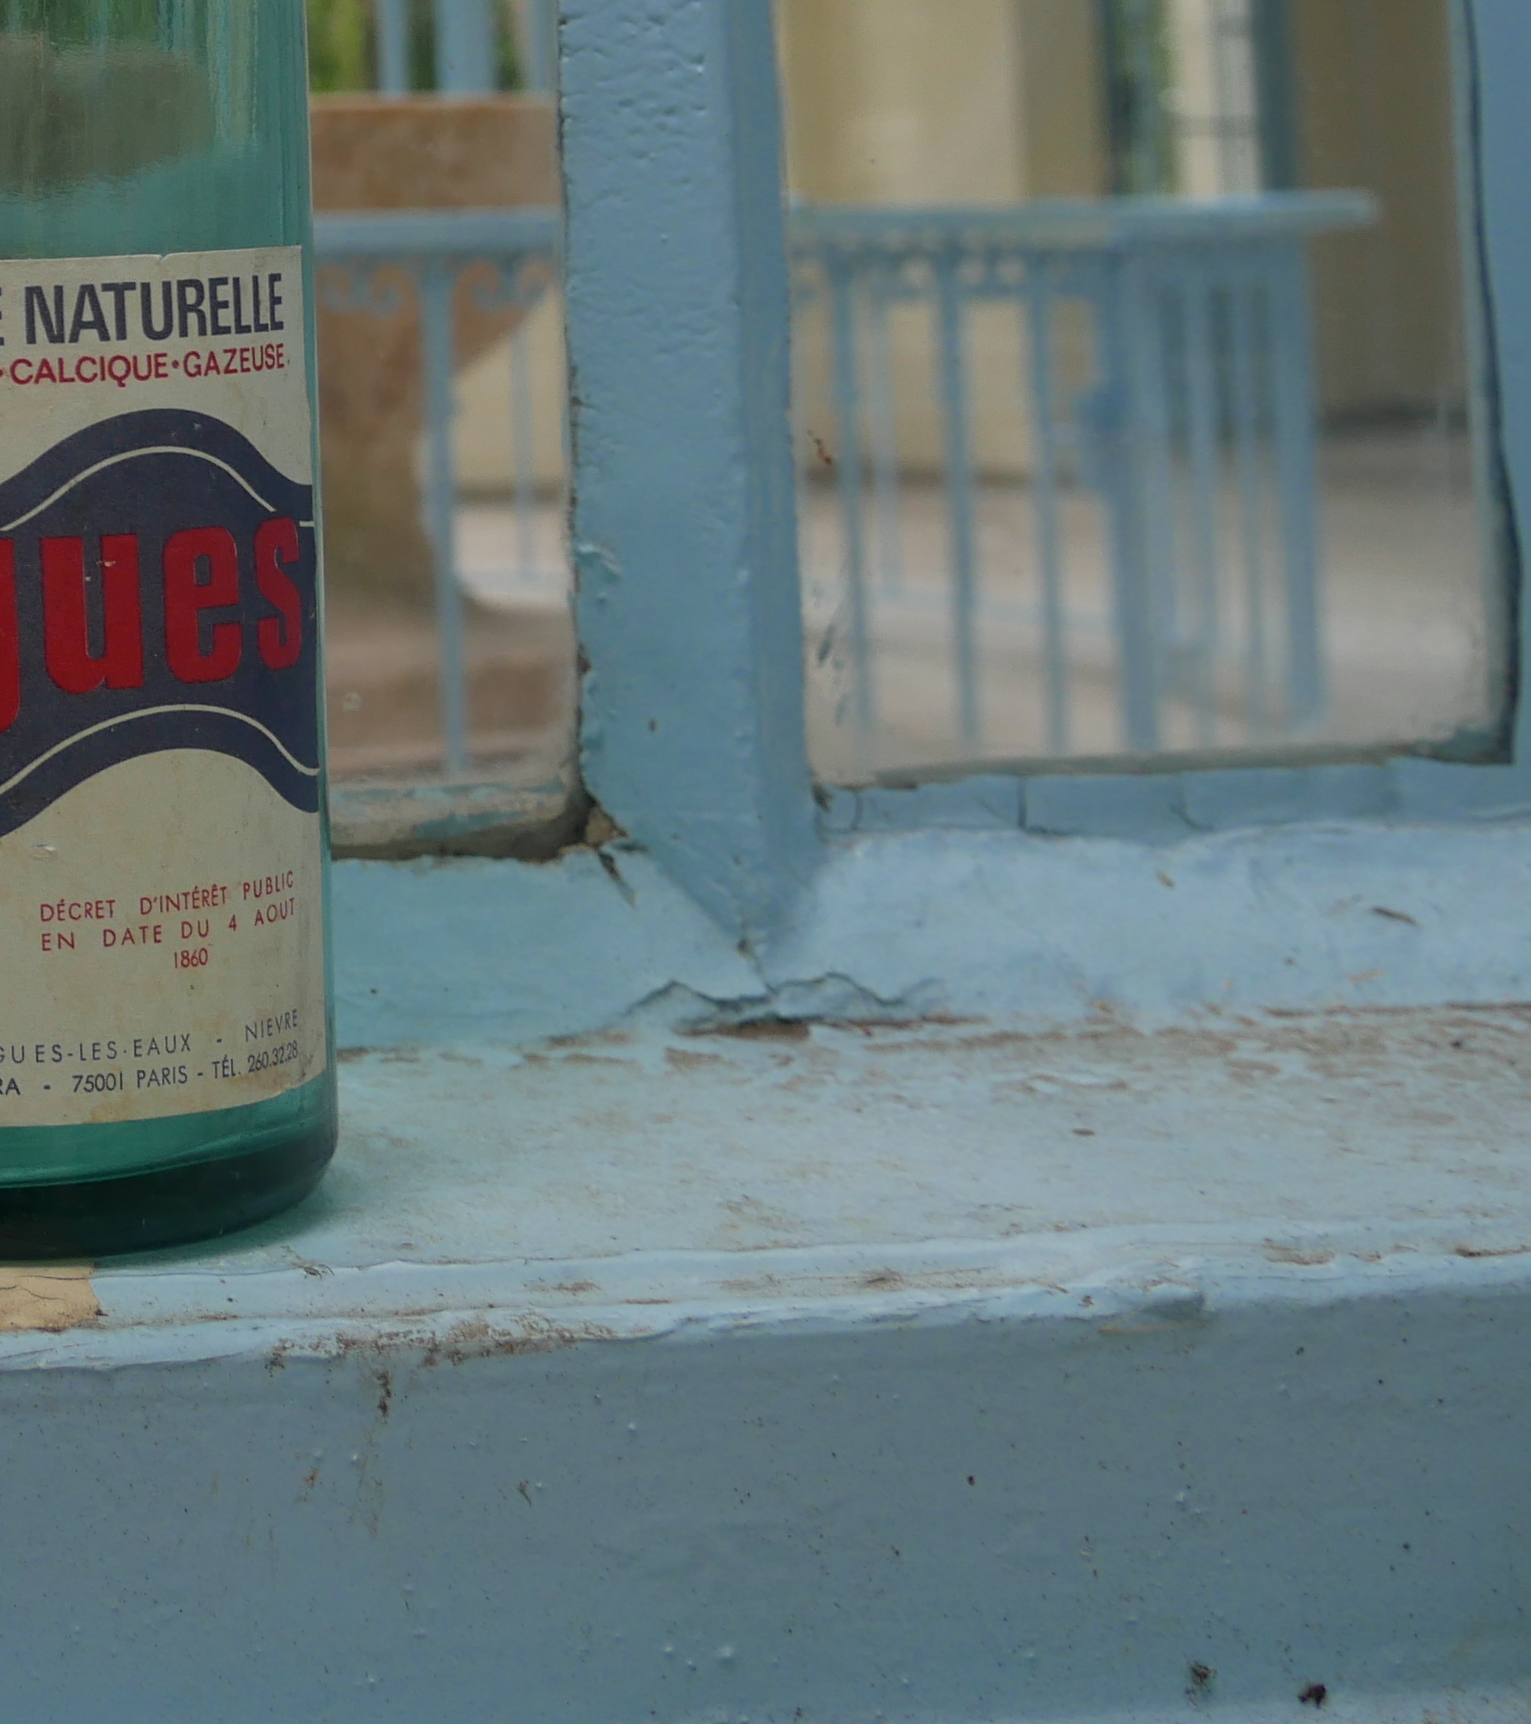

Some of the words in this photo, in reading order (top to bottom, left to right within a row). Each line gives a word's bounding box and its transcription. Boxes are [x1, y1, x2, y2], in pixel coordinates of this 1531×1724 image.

[24, 272, 285, 345] NATURELLE
[9, 351, 169, 389] CALCIQUE
[183, 342, 286, 377] GAZEUSE
[39, 898, 116, 923] DÉCRET
[139, 883, 228, 916] D'INTÉRÊT
[243, 870, 294, 901] PUBLIC
[41, 931, 76, 952] EN
[103, 925, 163, 948] DATE
[181, 919, 210, 940] DU
[227, 914, 238, 932] 4
[254, 897, 295, 927] AOUT
[174, 947, 209, 969] 1860
[245, 1008, 299, 1044] NIEVRE
[72, 1073, 124, 1094] 75001
[136, 1065, 189, 1089] PARIS
